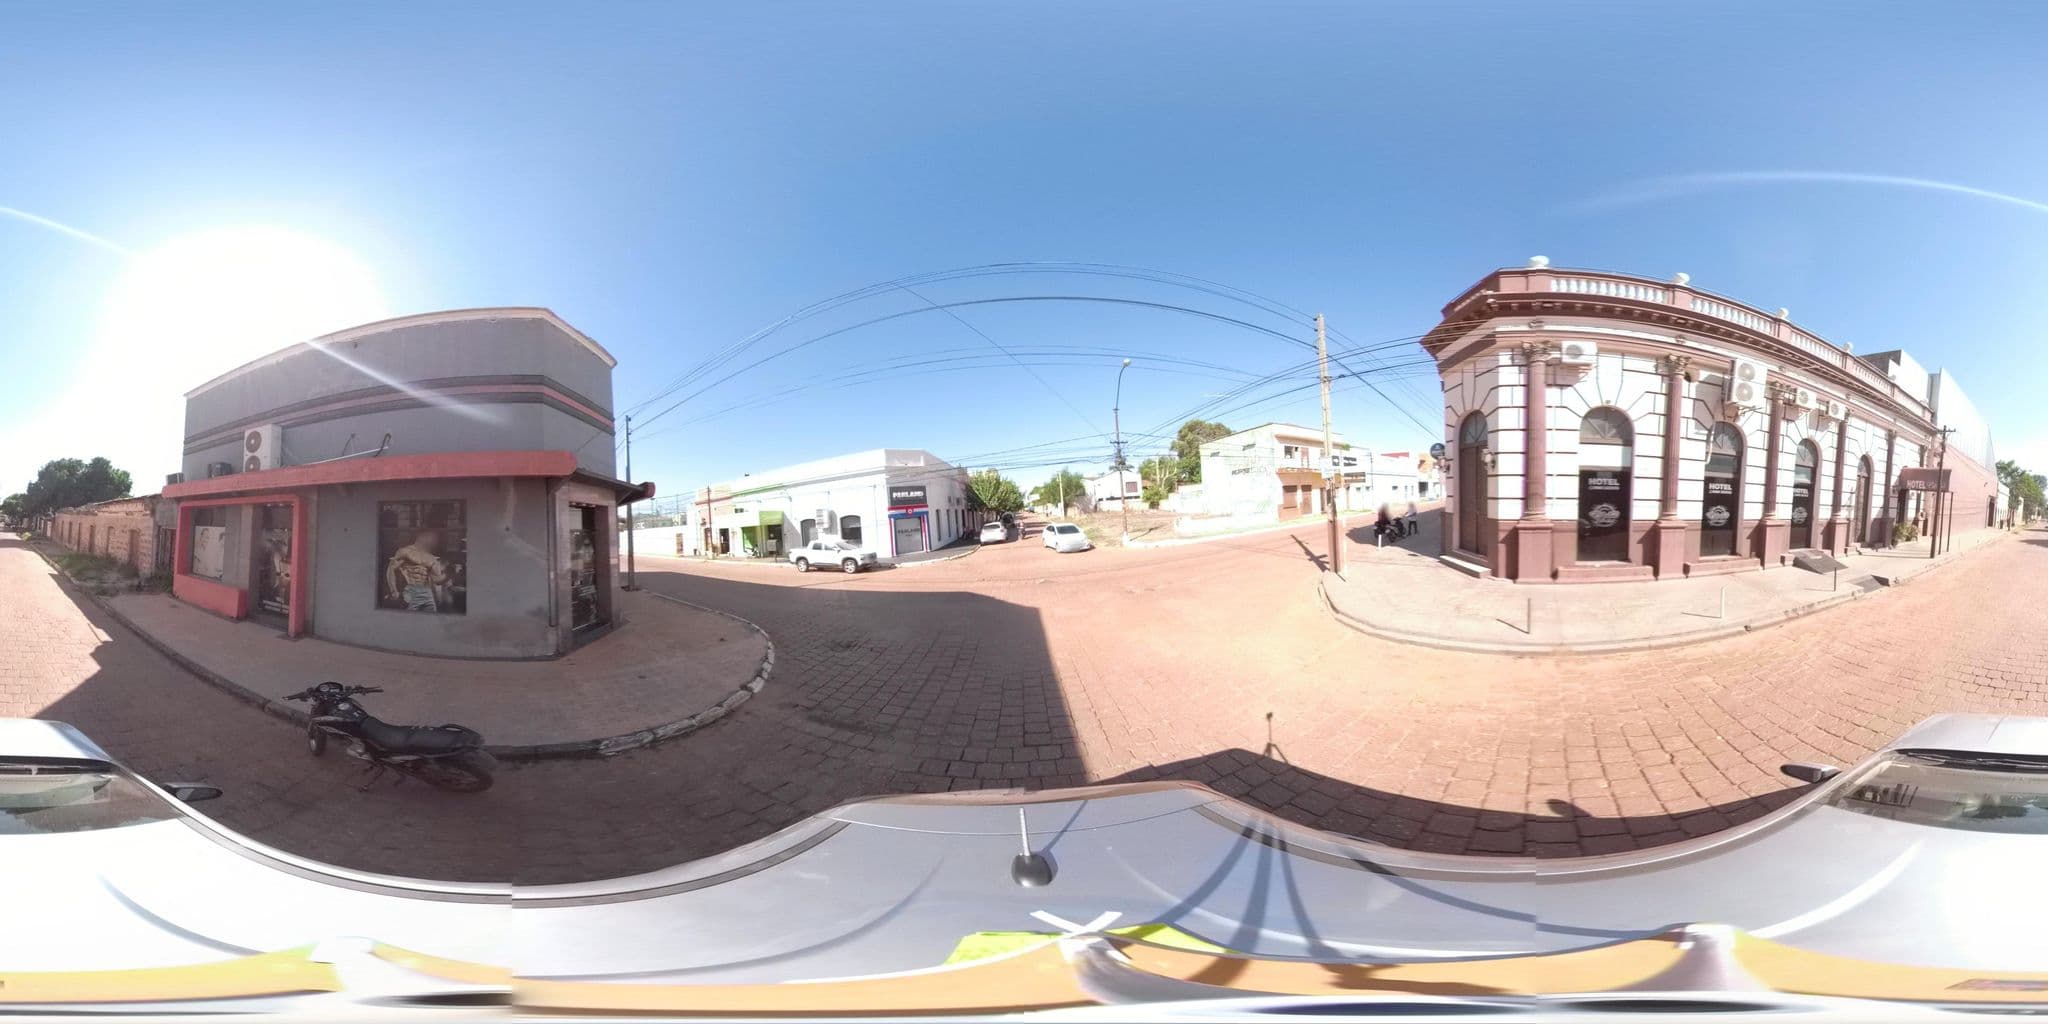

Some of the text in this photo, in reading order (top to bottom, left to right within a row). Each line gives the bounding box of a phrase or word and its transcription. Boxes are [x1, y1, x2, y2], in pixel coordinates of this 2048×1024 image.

[1588, 478, 1620, 486] HOTEL
[1906, 480, 1925, 489] HOTEL
[1708, 483, 1732, 491] HOTEL
